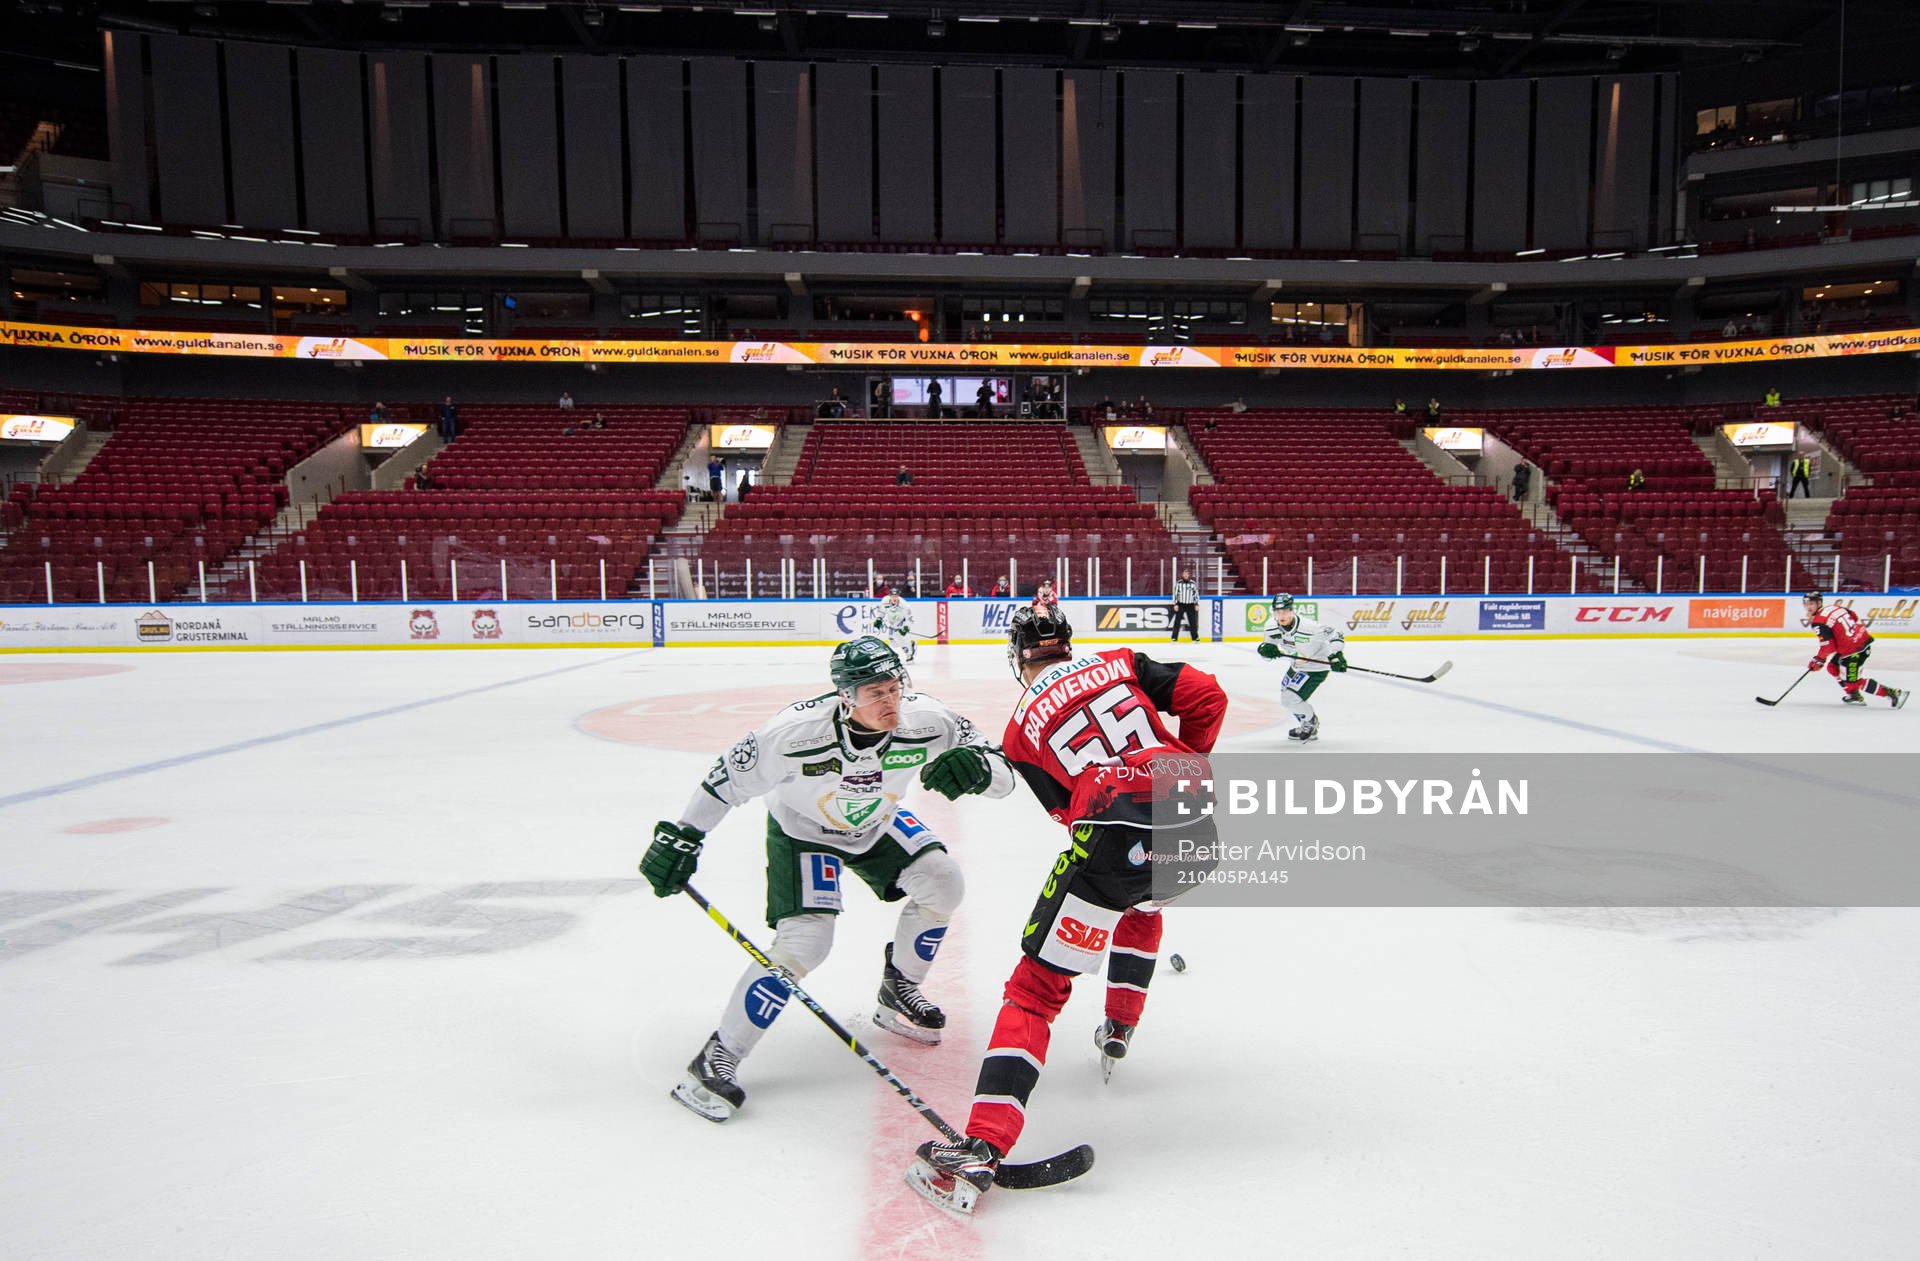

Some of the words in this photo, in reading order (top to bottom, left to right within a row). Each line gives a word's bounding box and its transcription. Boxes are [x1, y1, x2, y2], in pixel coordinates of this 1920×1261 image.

[1, 328, 64, 343] VUXNA
[134, 335, 283, 352] www.guldkanalen.se
[404, 344, 449, 356] MUSIK
[455, 344, 484, 357] FÖR
[488, 345, 536, 357] VUXNA
[592, 346, 720, 360] www.guldkanalen.se
[830, 348, 874, 360] MUSIK
[878, 348, 906, 361] FÖR
[910, 349, 955, 361] VUXNA
[1009, 350, 1130, 364] www.guldkanalen.se
[1235, 352, 1276, 364] MUSIK
[1280, 351, 1307, 364] FÖR
[1311, 353, 1353, 365] VUXNA
[1405, 353, 1521, 367] www.guldkanalen.se
[1630, 351, 1674, 363] MUSIK
[1680, 348, 1709, 361] FÖR
[1715, 346, 1764, 359] VUXNA
[528, 611, 645, 630] sandberg
[1347, 601, 1395, 631] guld
[1400, 601, 1449, 631] guld
[1575, 606, 1675, 622] CCM
[1703, 605, 1770, 621] navigator
[1861, 599, 1919, 628] guld
[175, 618, 222, 631] NORDANÅ
[176, 631, 249, 642] GRUSTERMINAL
[1031, 654, 1103, 697] bravida
[1024, 658, 1132, 752] BARNEKOW
[1048, 683, 1167, 777] 55
[885, 753, 924, 766] coop
[1056, 916, 1110, 952] SVB
